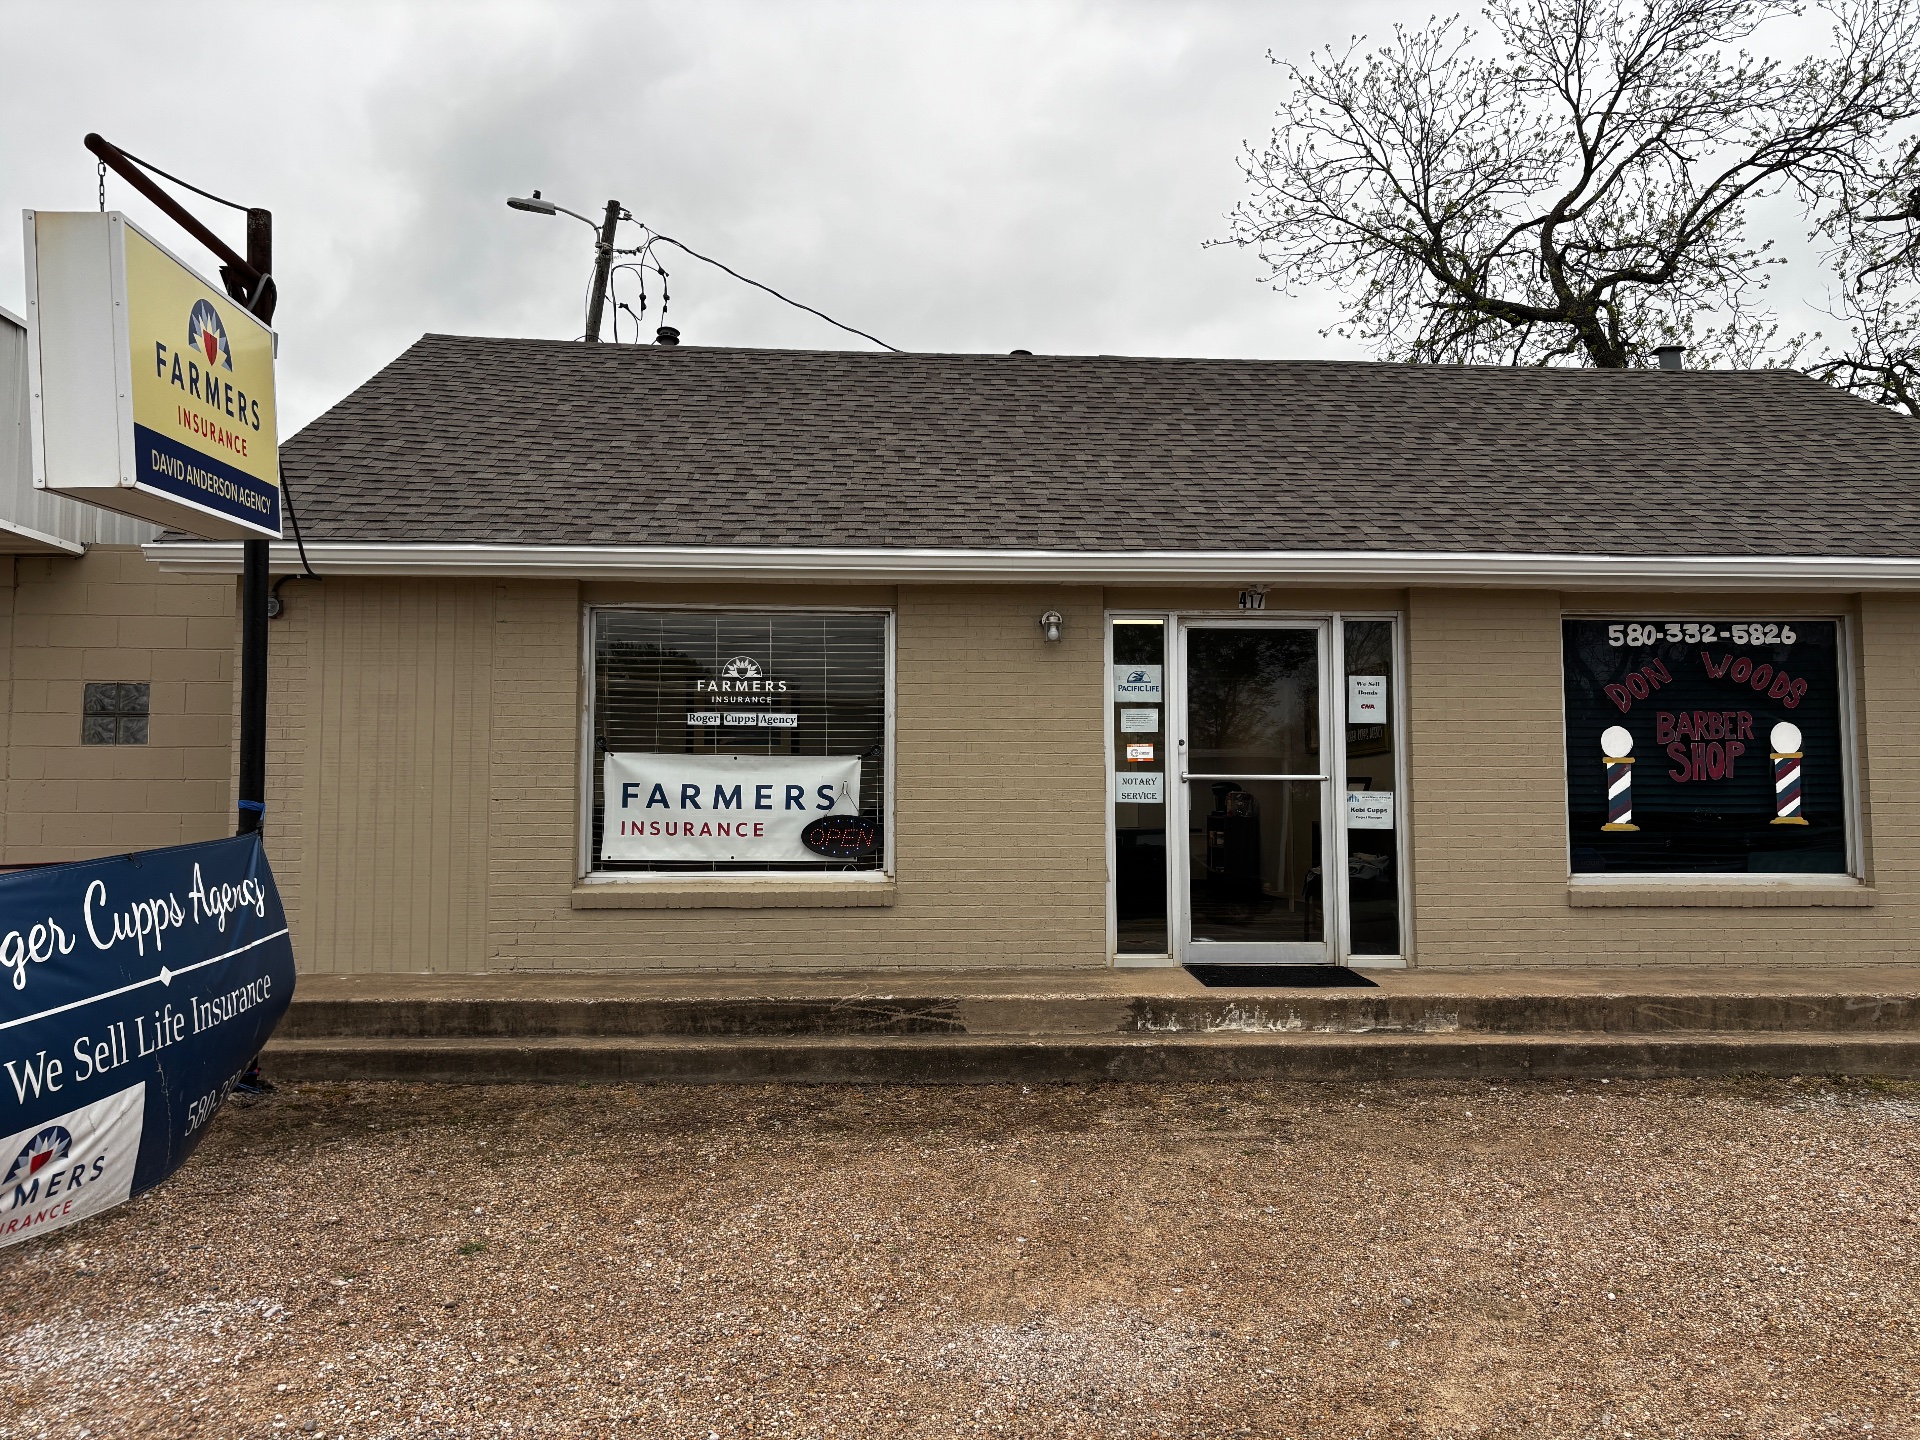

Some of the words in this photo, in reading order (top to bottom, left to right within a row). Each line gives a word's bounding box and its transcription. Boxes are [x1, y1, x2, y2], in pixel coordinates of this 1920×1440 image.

[156, 341, 260, 432] FARMERS
[178, 405, 248, 458] INSURANCE
[152, 448, 184, 481] DAVID
[186, 468, 238, 501] ANDERSON
[239, 488, 271, 515] AGENCY
[1240, 592, 1264, 608] 417
[1608, 624, 1796, 646] 580-332-5826
[698, 680, 786, 692] FARMERS
[1604, 658, 1672, 713] DON
[1701, 652, 1807, 708] WOODS
[688, 714, 719, 724] Roger
[724, 714, 756, 725] Cupps
[759, 715, 796, 725] Agency
[1656, 710, 1754, 744] BARBER
[1667, 741, 1745, 782] SHOP
[621, 782, 835, 811] FARMERS
[1122, 777, 1157, 785] NOTARY
[1122, 792, 1157, 800] SERVICE
[620, 821, 764, 837] INSURANCE
[810, 828, 874, 847] OPEN
[84, 880, 186, 956] Cupps
[188, 862, 265, 932] Agency
[3, 1050, 64, 1105] We
[74, 1020, 129, 1082] Sell
[135, 1004, 185, 1058] Life
[191, 974, 272, 1034] Insurance
[0, 1155, 105, 1213] MERS
